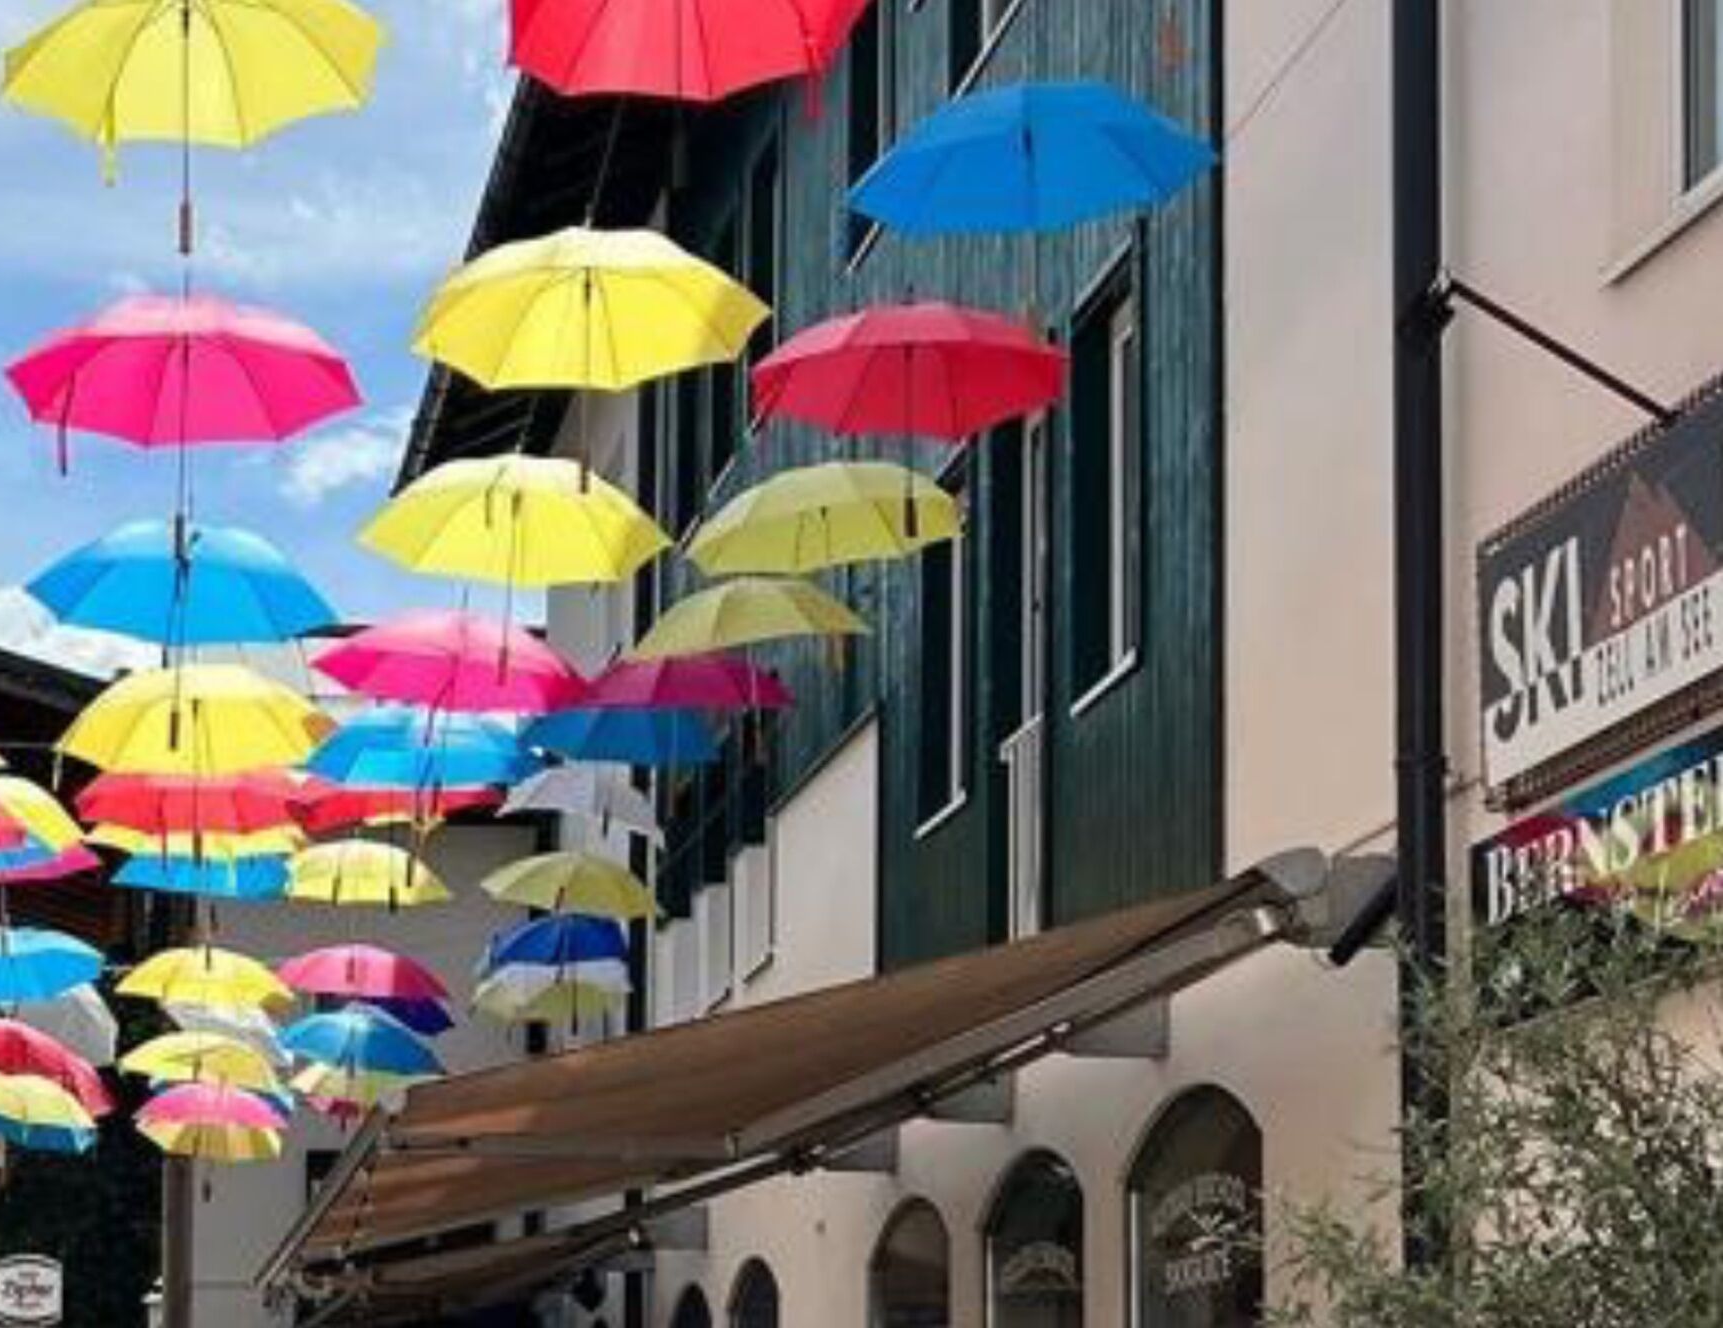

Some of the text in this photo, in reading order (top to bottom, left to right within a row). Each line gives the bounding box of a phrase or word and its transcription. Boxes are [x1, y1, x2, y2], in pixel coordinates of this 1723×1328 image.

[1490, 522, 1688, 743] SKI SPORT
[1596, 584, 1714, 706] ZELL AM SEE
